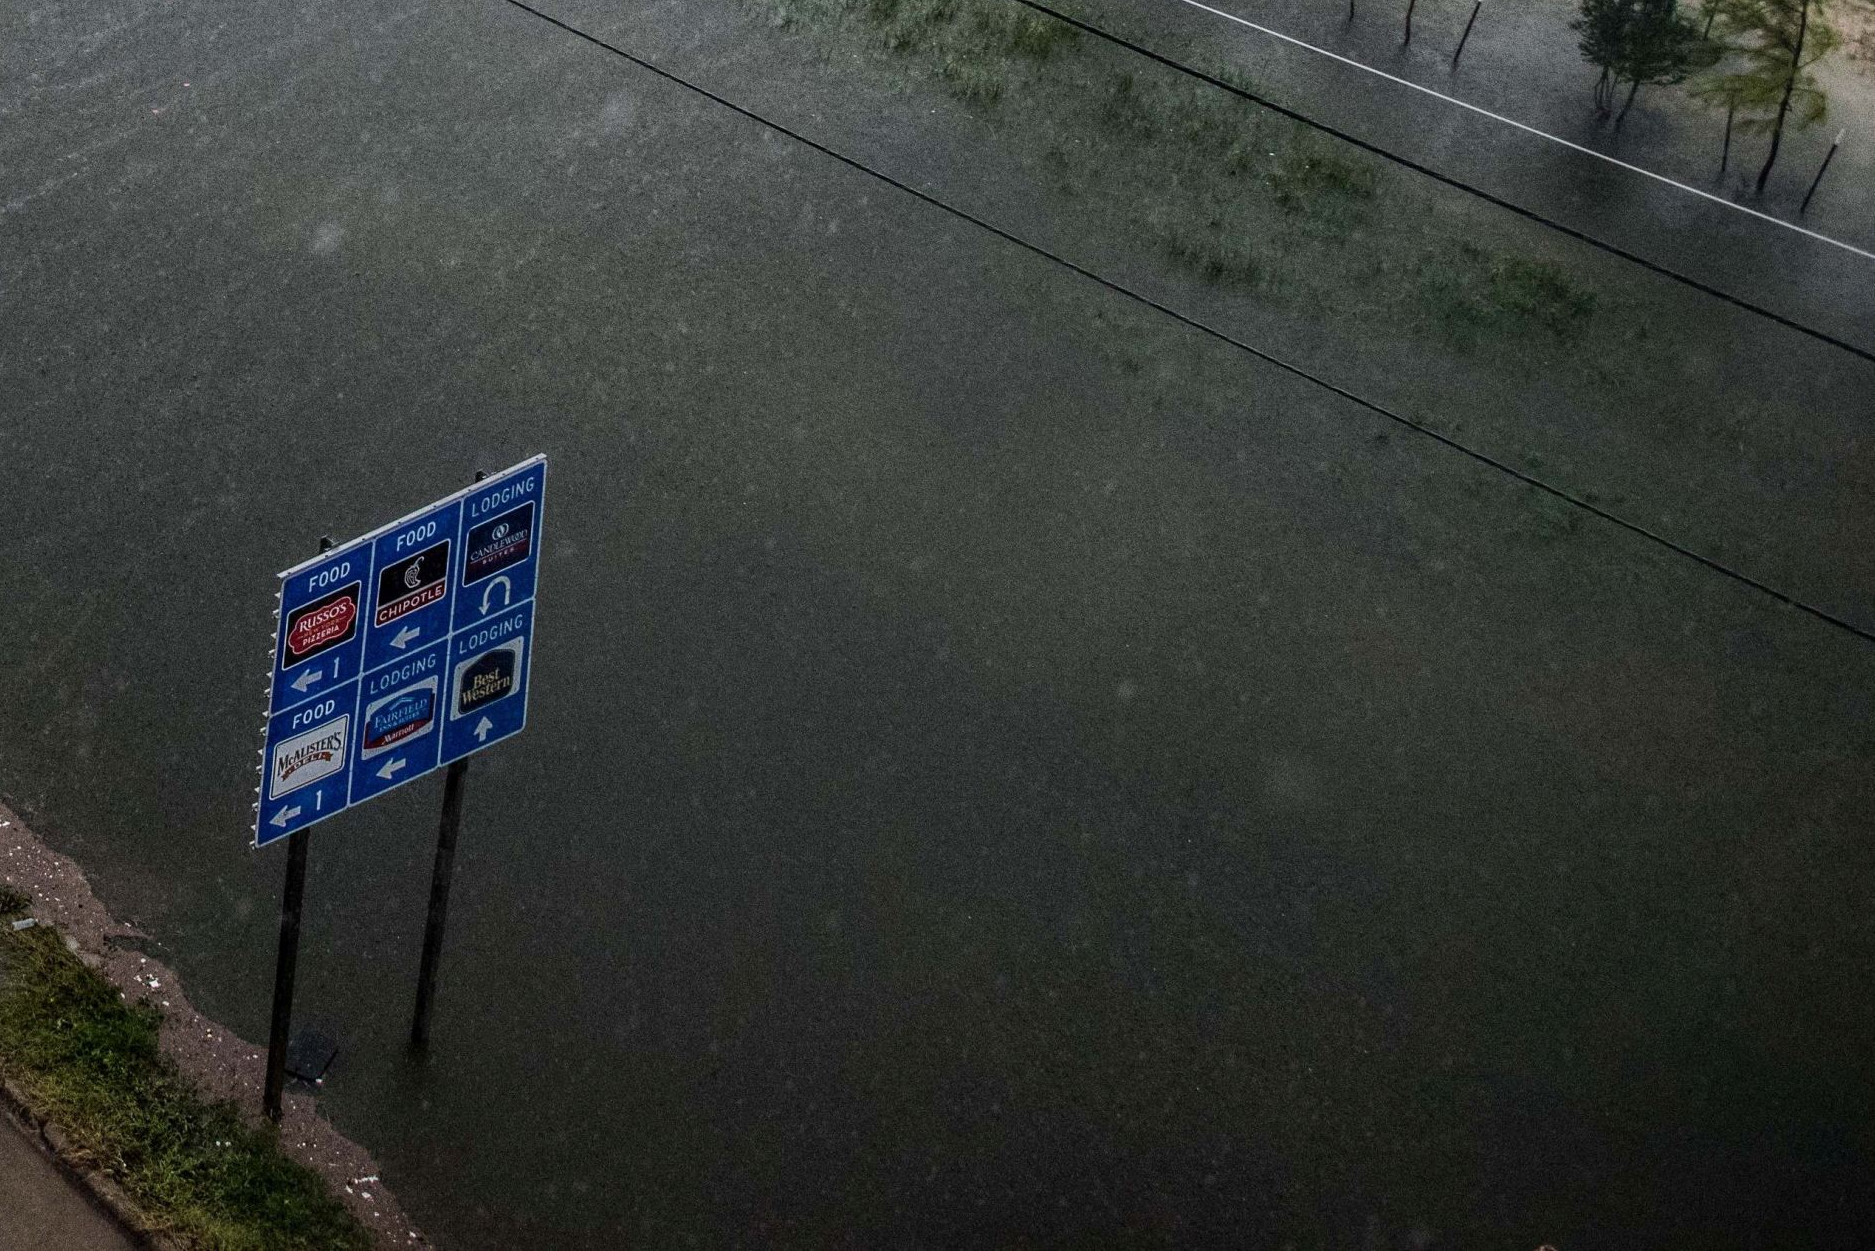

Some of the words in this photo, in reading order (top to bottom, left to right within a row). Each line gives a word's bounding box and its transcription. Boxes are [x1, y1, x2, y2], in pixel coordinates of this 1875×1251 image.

[471, 476, 535, 517] LODGING
[396, 521, 436, 552] FOOD
[470, 529, 528, 561] CANDLEWOOD
[483, 547, 514, 564] SUITES
[309, 562, 351, 593] FOOD
[299, 602, 347, 632] RUSSO'S
[379, 585, 443, 621] CHIPOTLE
[302, 625, 340, 646] PIZZERIA
[459, 614, 523, 654] LODGING
[333, 656, 340, 679] 1
[370, 653, 436, 695] LODGING
[474, 667, 500, 689] Best
[462, 676, 510, 705] Western
[292, 700, 335, 729] FOOD
[374, 698, 428, 729] FAIRFIELD
[277, 732, 342, 776] McALISTER'S
[316, 790, 322, 811] 1
